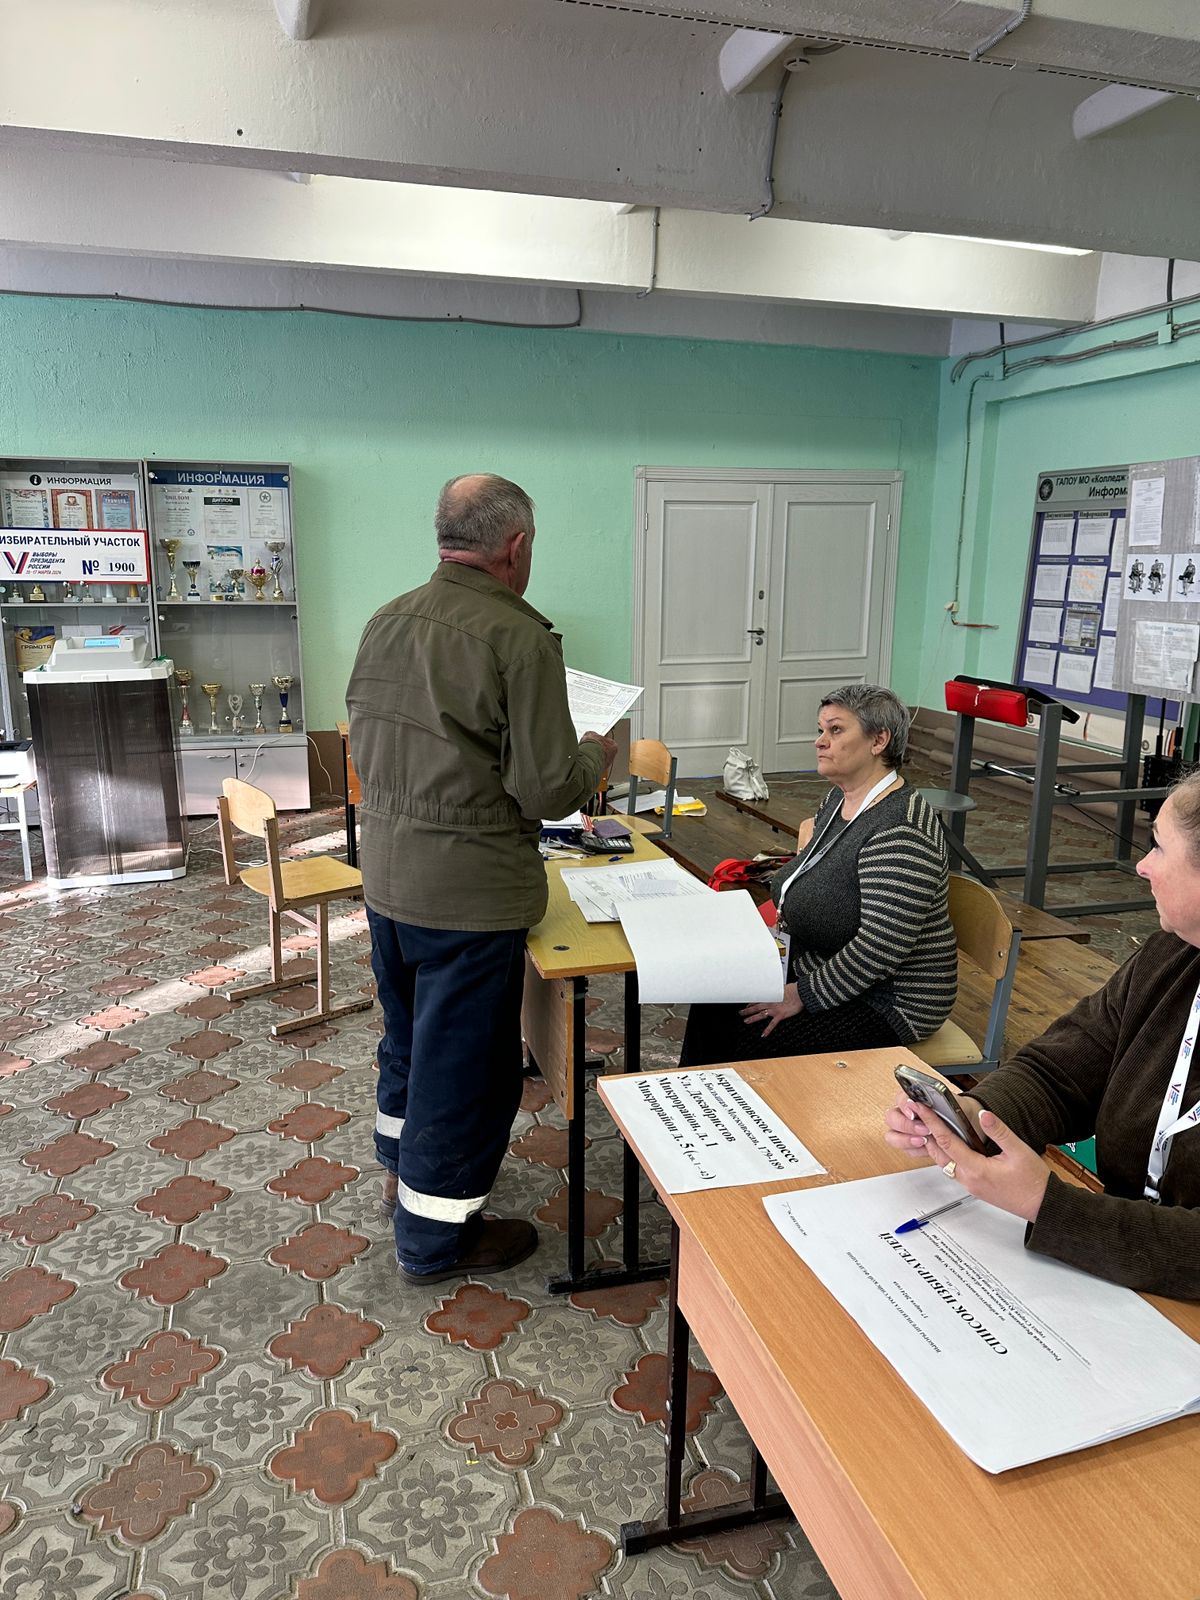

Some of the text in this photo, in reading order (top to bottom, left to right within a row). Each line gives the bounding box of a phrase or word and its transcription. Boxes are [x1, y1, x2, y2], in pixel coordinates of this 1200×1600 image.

[47, 476, 112, 486] ИНФОРМАЦИЯ
[177, 473, 265, 486] ИНФОРМАЦИЯ
[1056, 476, 1077, 486] ГАПОУ
[1078, 476, 1090, 484] МО
[0, 535, 140, 546] ИЗБИРАТЕЛЬНЫЙ УЧАСТОК
[82, 560, 135, 575] № 1900
[633, 1080, 682, 1132] Микрорайон
[670, 1132, 686, 1141] д.
[654, 1077, 706, 1131] Микрорайон,
[694, 1131, 711, 1140] д.
[675, 1075, 739, 1142] Ул. Декабристов
[703, 1082, 731, 1107] Большая
[756, 1146, 786, 1170] 179-189
[711, 1072, 773, 1133] Акрихиновское
[766, 1135, 800, 1163] шоссе
[876, 1232, 958, 1303] ИЗБИРАТЕЛЕЙ
[950, 1304, 1010, 1355] СПИСОК
